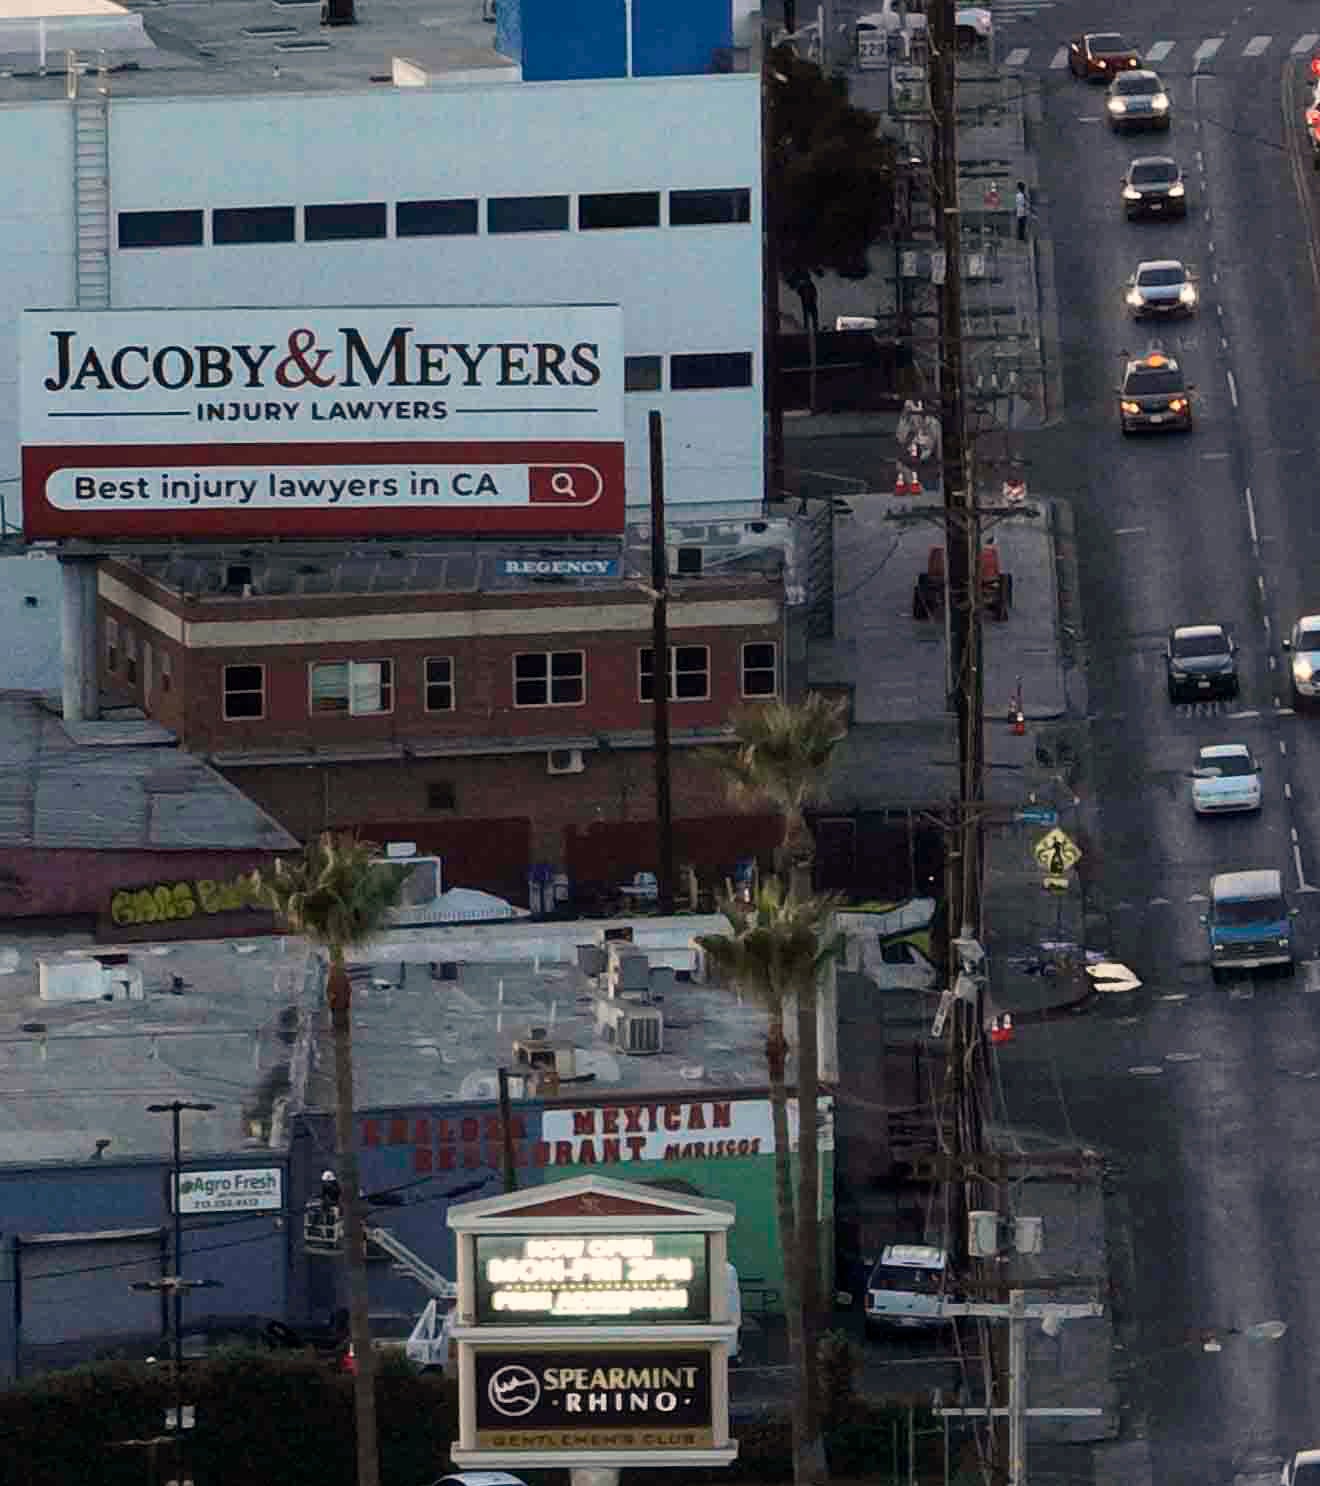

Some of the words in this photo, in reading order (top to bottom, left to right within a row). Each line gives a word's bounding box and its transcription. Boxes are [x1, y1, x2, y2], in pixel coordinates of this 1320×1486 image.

[197, 402, 300, 422] INJURY
[311, 401, 449, 422] LAWYERS
[74, 476, 150, 500] Best
[161, 473, 257, 504] injury
[268, 471, 398, 503] lawyers
[410, 470, 439, 497] in
[452, 472, 499, 497] CA
[504, 560, 609, 574] REGENCY
[573, 1102, 732, 1136] MEXICAN
[193, 1176, 232, 1196] Agro
[543, 1366, 699, 1391] SPEARMINT
[564, 1392, 678, 1413] RHINO
